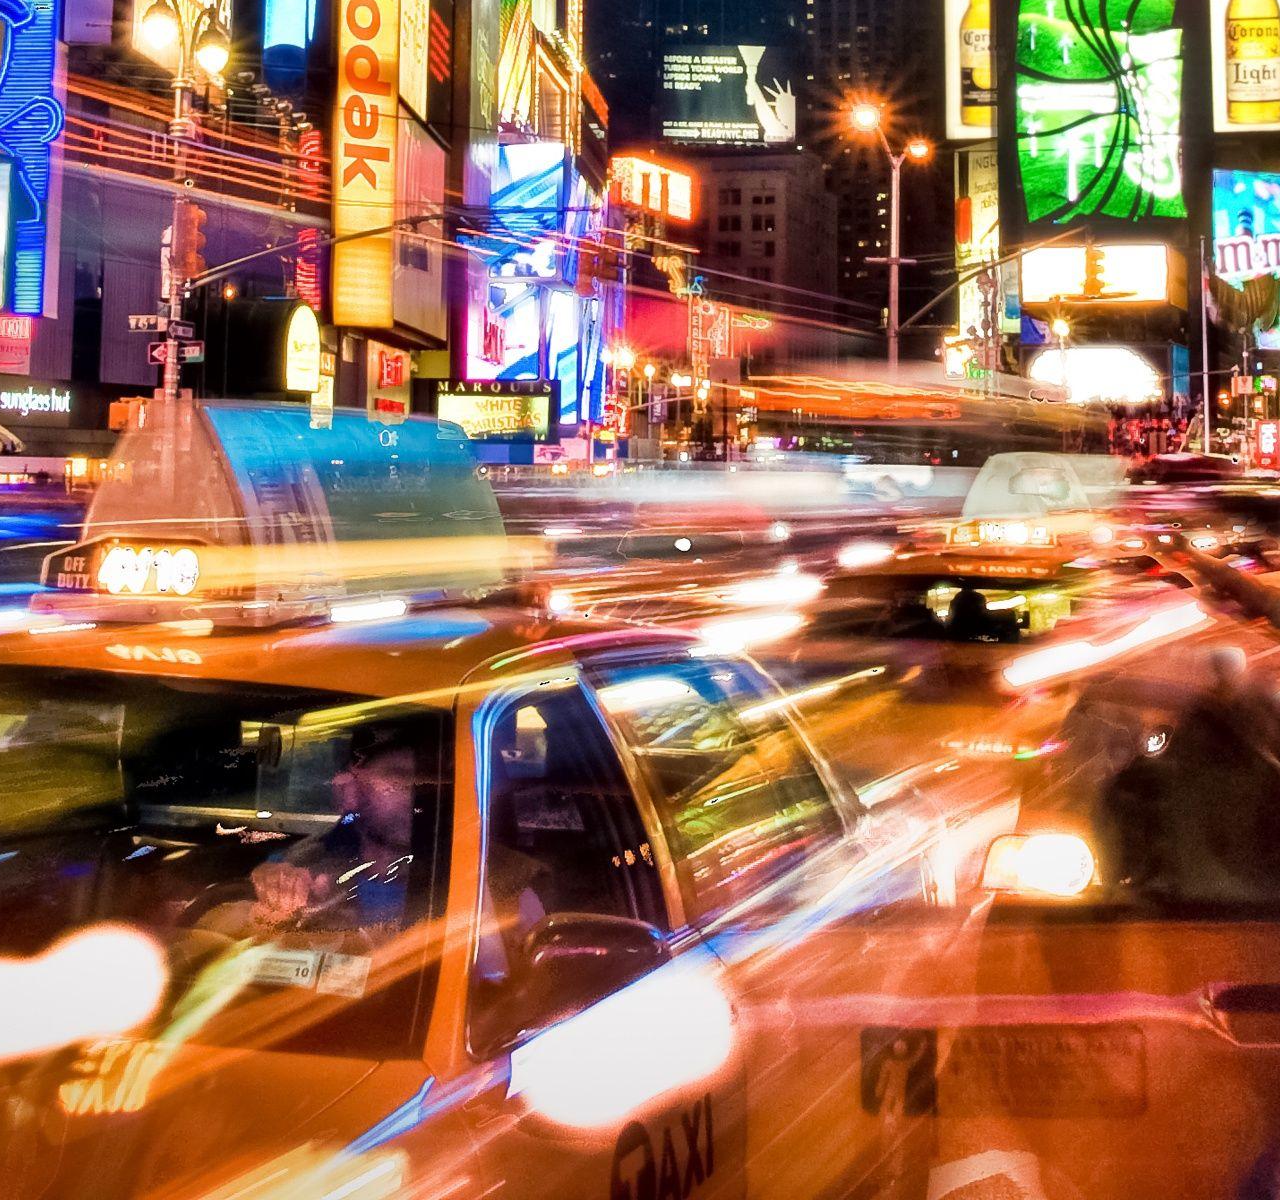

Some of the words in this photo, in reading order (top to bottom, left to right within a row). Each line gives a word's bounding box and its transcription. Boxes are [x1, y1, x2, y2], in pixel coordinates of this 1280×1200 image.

[1227, 23, 1280, 42] Corona
[1233, 62, 1277, 85] Light
[437, 381, 553, 392] MARQUIS
[0, 386, 51, 417] sunglass
[51, 387, 71, 413] hut
[476, 398, 523, 412] WHITE
[64, 556, 87, 572] OFF
[57, 572, 91, 589] DUTY
[294, 966, 310, 978] 10
